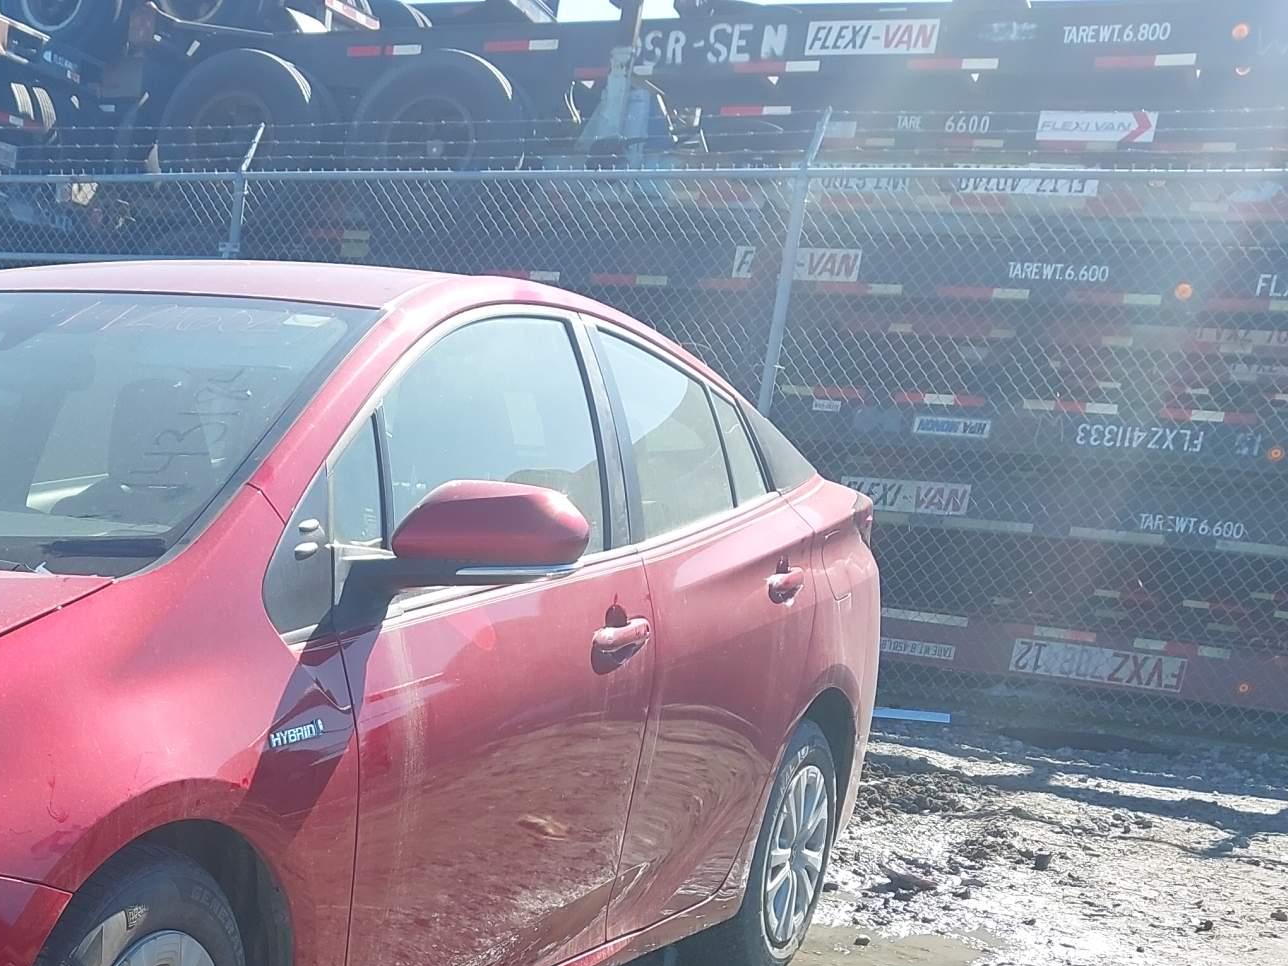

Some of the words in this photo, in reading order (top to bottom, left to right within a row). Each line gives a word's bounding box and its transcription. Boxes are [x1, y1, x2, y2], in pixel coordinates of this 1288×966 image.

[808, 24, 936, 51] FLEXI-VAN
[896, 115, 921, 129] TARE
[944, 115, 990, 133] 6600
[270, 722, 315, 748] HYBRID
